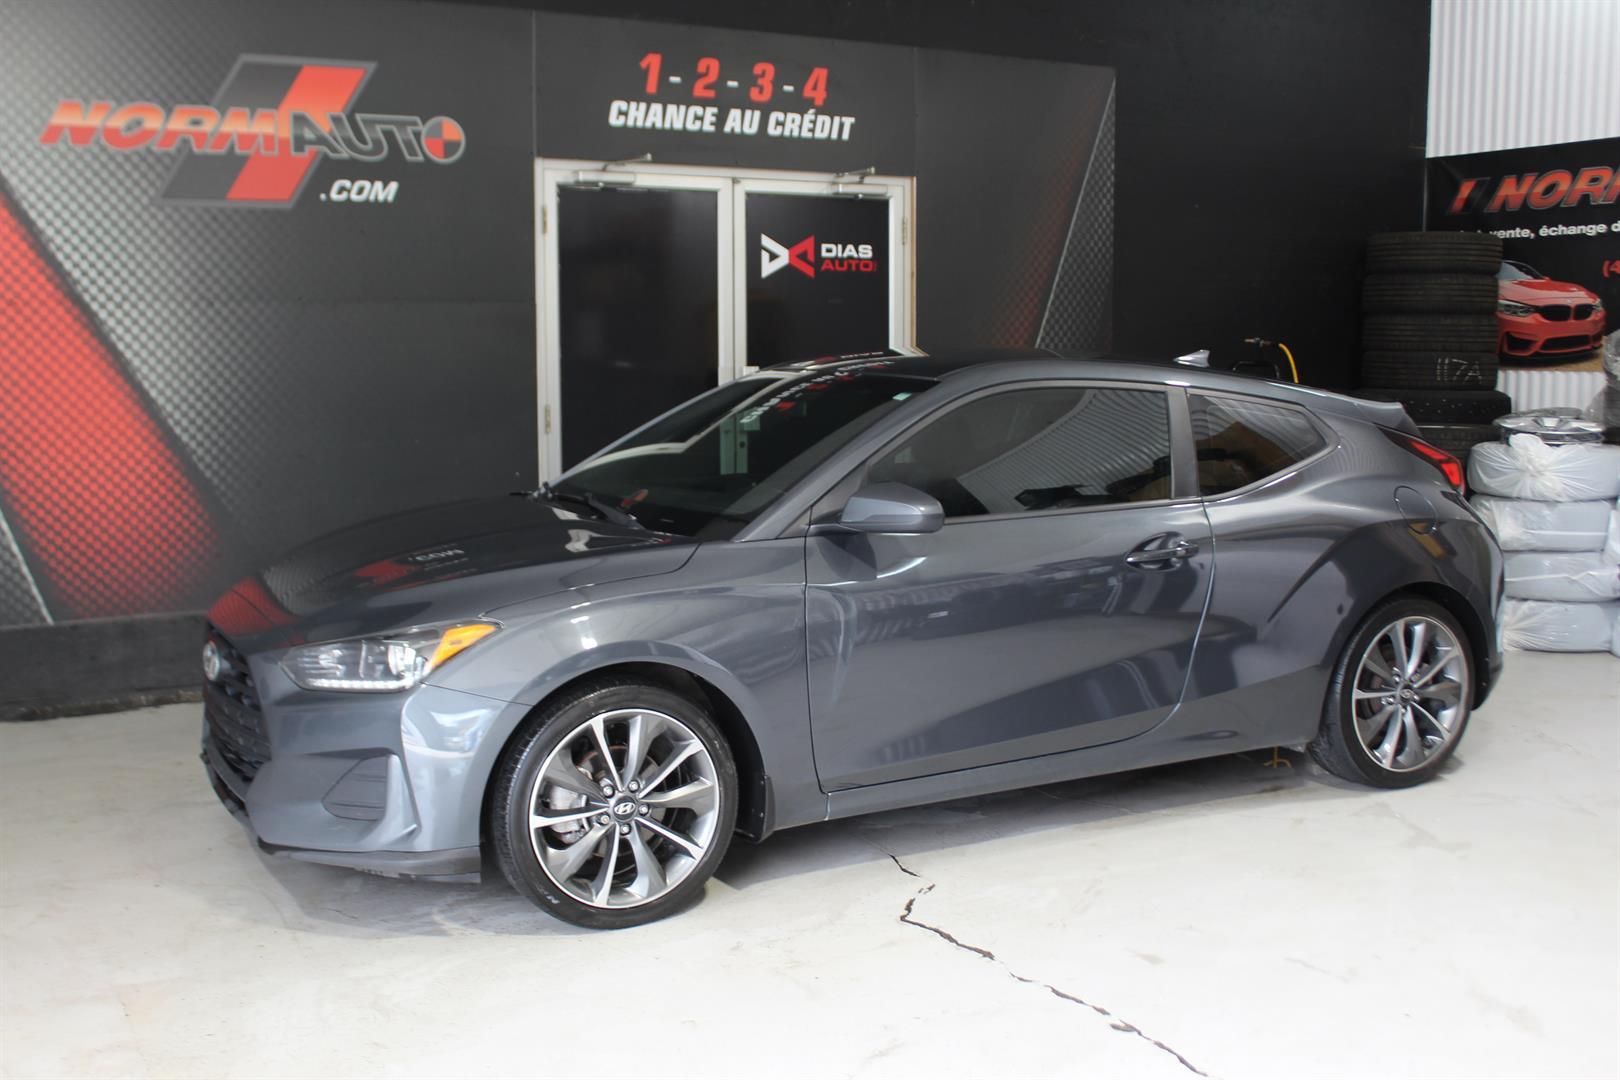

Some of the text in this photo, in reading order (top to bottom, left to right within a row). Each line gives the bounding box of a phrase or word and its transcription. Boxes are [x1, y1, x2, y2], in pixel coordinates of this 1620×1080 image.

[608, 100, 856, 141] CHANCE AU CRÉDIT
[1483, 165, 1620, 213] NOR
[1538, 224, 1608, 237] échange
[820, 243, 873, 258] DIAS
[820, 259, 874, 272] AUTO
